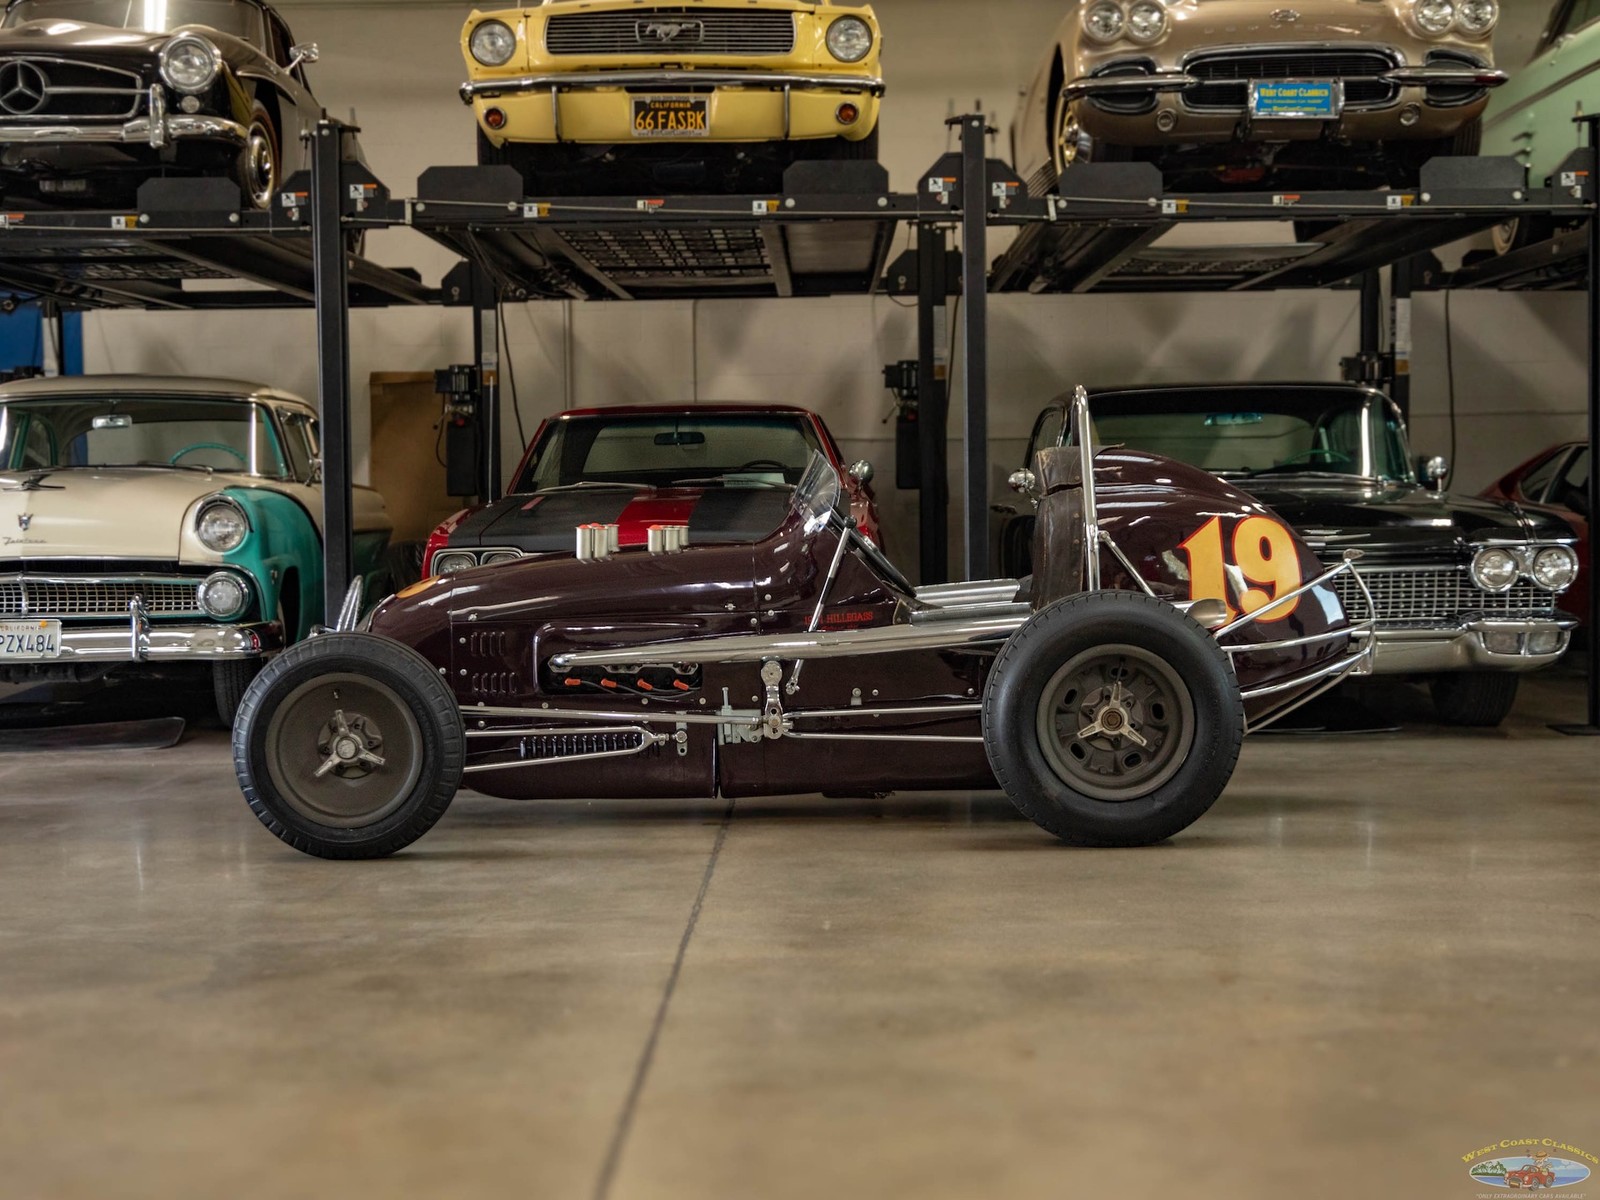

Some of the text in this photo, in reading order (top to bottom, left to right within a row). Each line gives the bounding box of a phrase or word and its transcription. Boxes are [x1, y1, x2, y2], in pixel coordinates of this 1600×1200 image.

[650, 101, 692, 109] CALIFORNIA
[1177, 514, 1302, 630] 19
[826, 611, 874, 624] HILLEGASS
